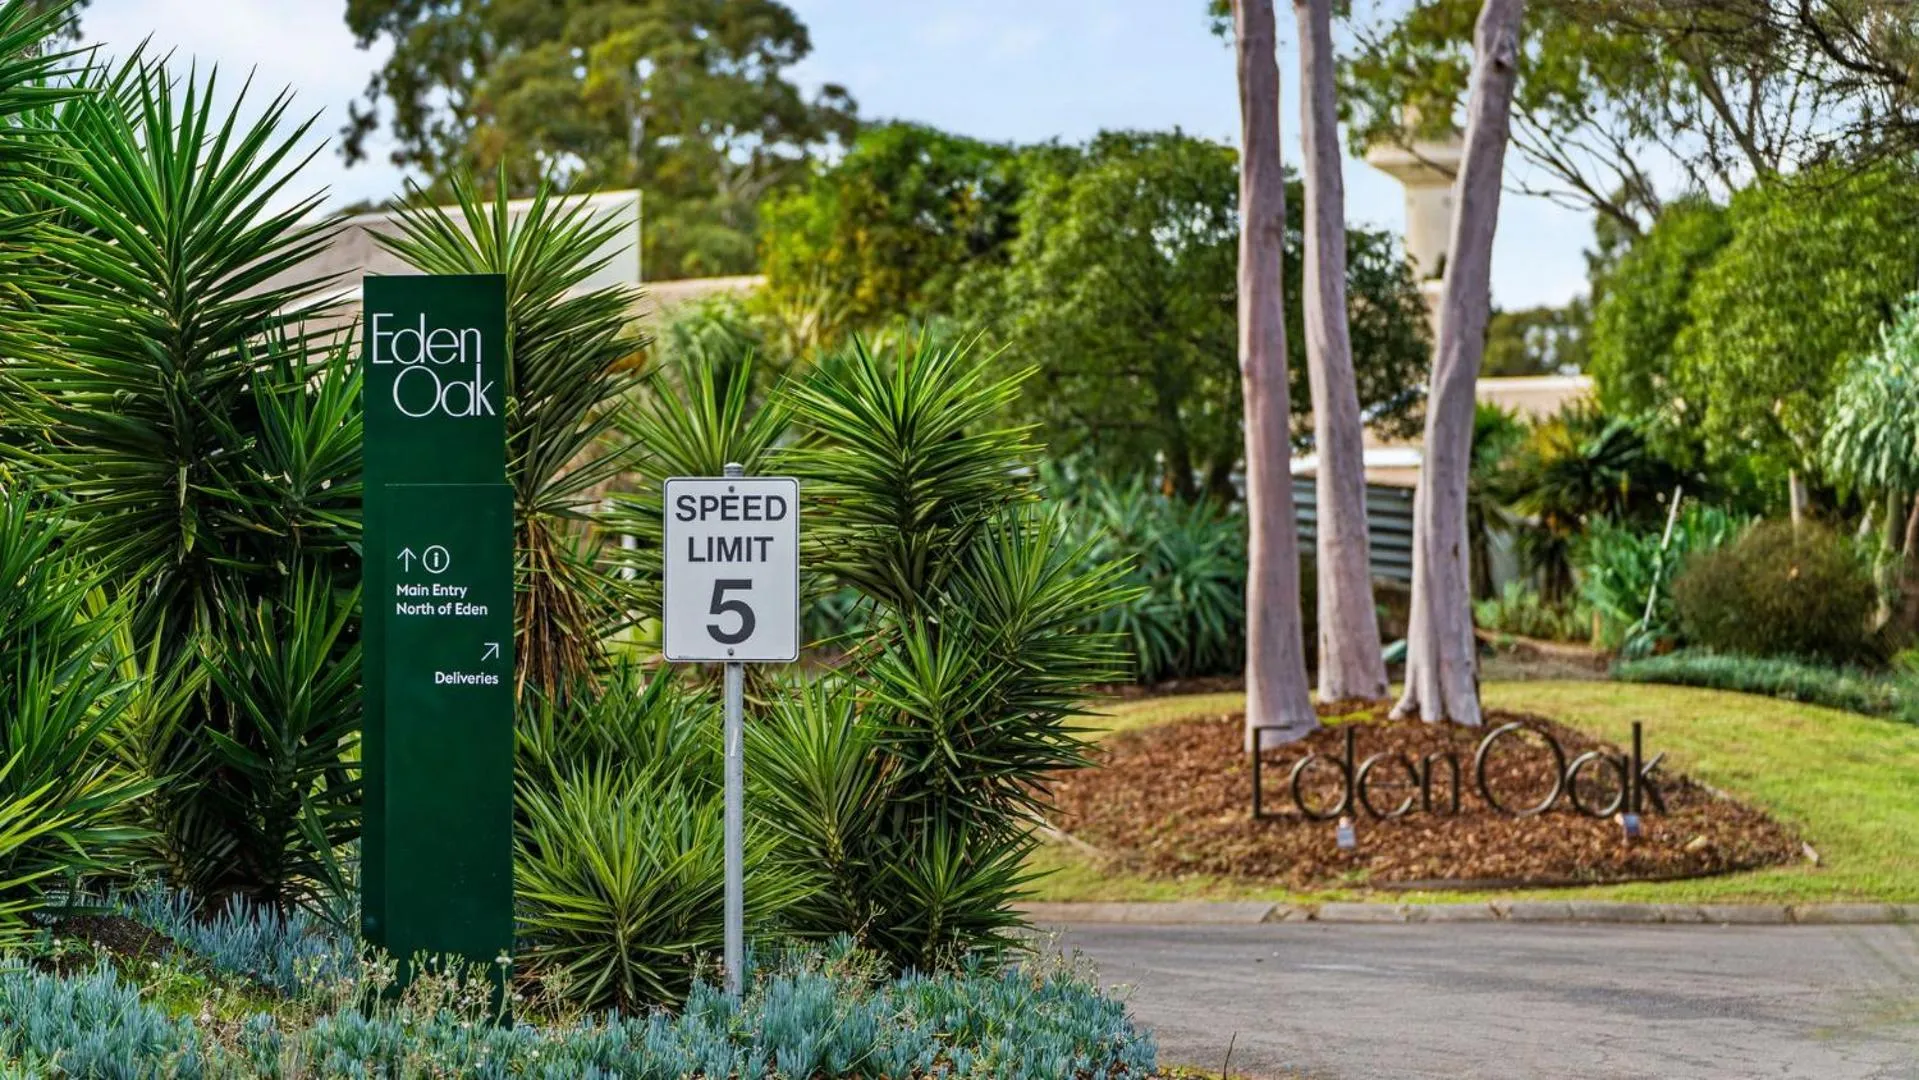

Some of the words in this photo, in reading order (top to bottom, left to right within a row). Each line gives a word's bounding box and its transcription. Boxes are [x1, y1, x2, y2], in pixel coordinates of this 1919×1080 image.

[372, 313, 482, 364] Eden
[393, 364, 496, 417] Oak
[675, 495, 787, 521] SPEED
[687, 536, 774, 563] LIMIT
[396, 584, 430, 597] Main
[432, 584, 468, 599] Entry
[396, 602, 435, 615] North
[438, 602, 453, 615] of
[455, 602, 488, 616] Eden
[706, 579, 756, 645] 5
[434, 671, 499, 685] Deliveries
[1253, 725, 1460, 820] Eden
[1475, 721, 1666, 820] Oak
